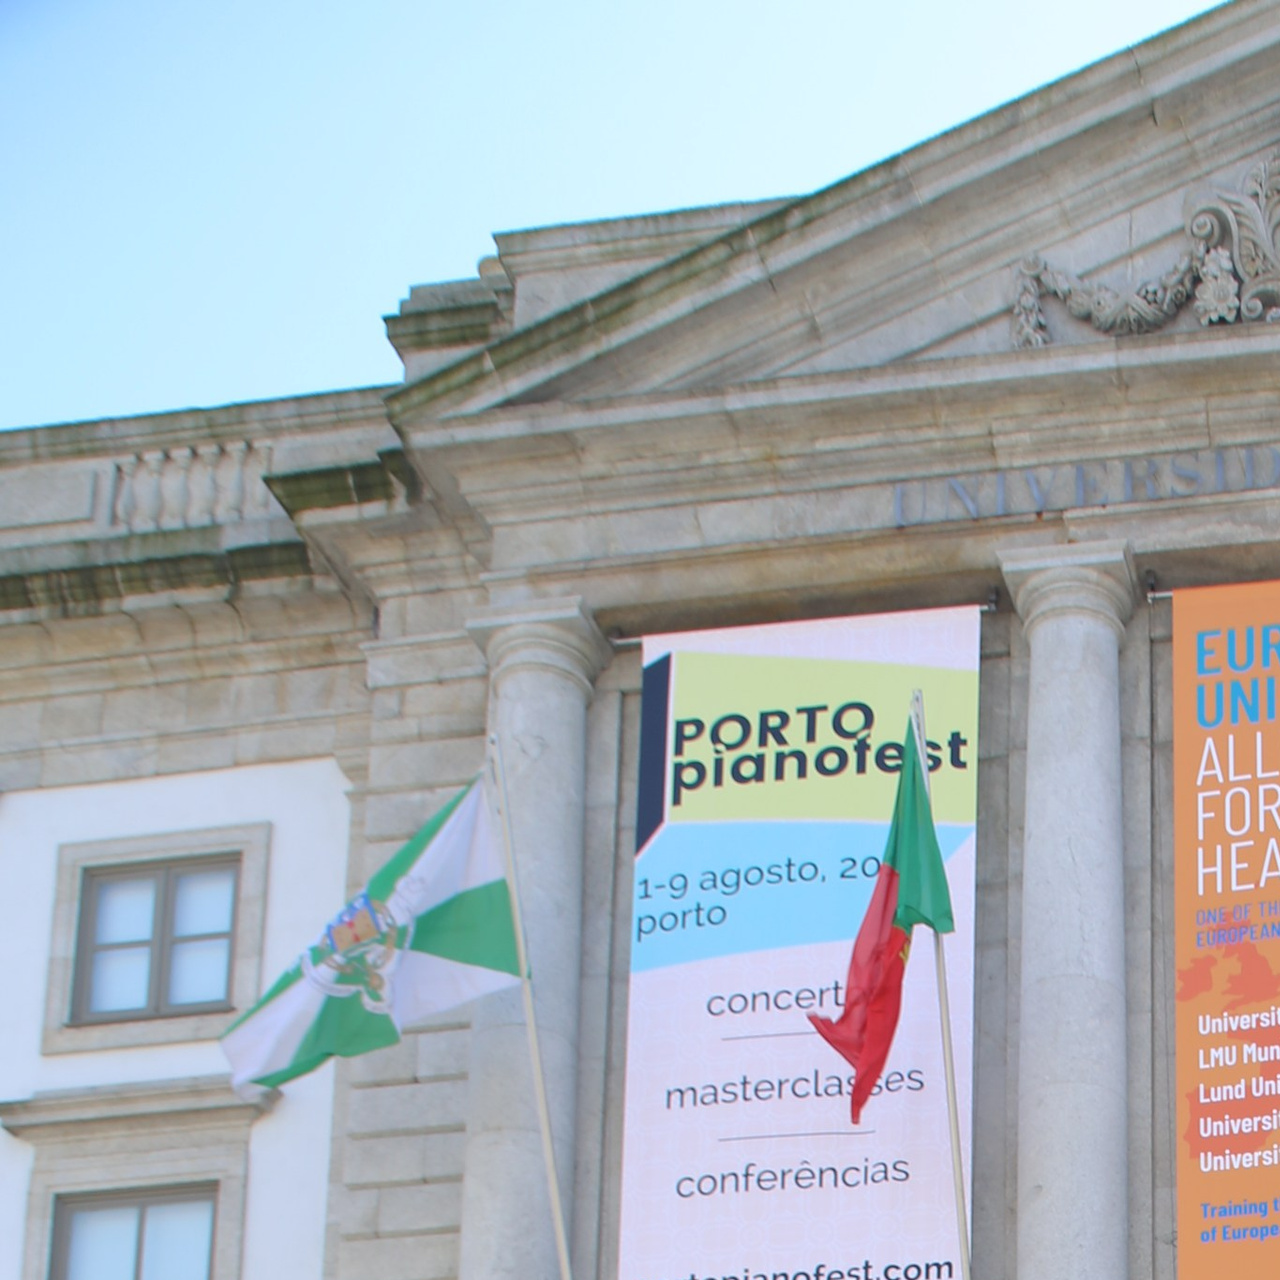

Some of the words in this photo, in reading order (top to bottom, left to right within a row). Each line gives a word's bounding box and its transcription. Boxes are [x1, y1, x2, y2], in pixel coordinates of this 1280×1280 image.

[674, 702, 875, 757] PORTO
[672, 731, 968, 806] pianofest
[638, 873, 688, 900] 1-9
[700, 858, 826, 895] agosto,
[840, 856, 881, 878] 20
[637, 902, 727, 943] porto
[1196, 907, 1227, 926] ONE
[1232, 904, 1252, 922] OF
[706, 980, 845, 1017] concert
[1199, 1046, 1237, 1069] LMU
[1199, 1079, 1245, 1104] Lund
[676, 1157, 910, 1198] conferências
[1201, 1199, 1268, 1219] Training
[1200, 1227, 1217, 1243] of
